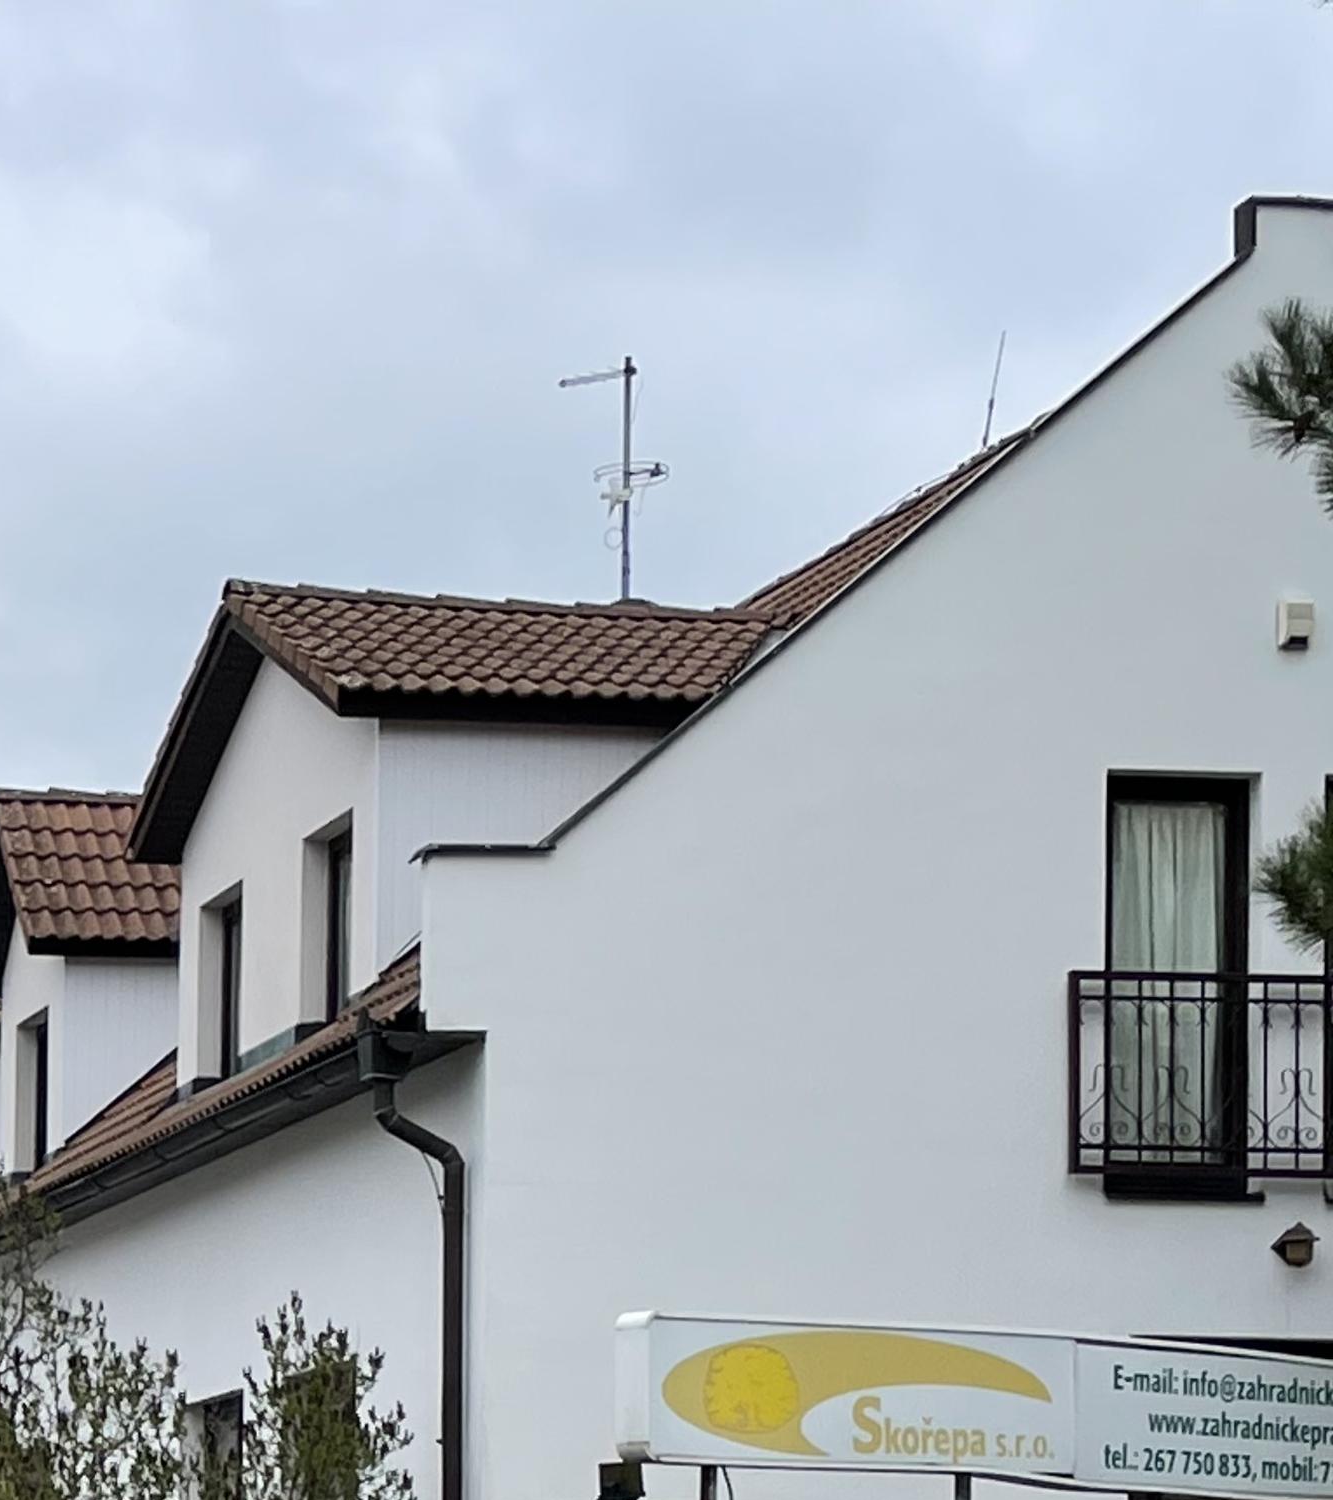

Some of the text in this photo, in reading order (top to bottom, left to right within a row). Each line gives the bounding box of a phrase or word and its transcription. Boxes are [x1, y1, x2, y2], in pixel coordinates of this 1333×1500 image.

[1113, 1364, 1180, 1395] E-mail:
[852, 1395, 1056, 1465] Skořepa s.r.o.
[1104, 1442, 1140, 1471] tel.:
[1143, 1448, 1176, 1472] 267
[1181, 1451, 1214, 1475] 750
[1218, 1453, 1259, 1482] 833,
